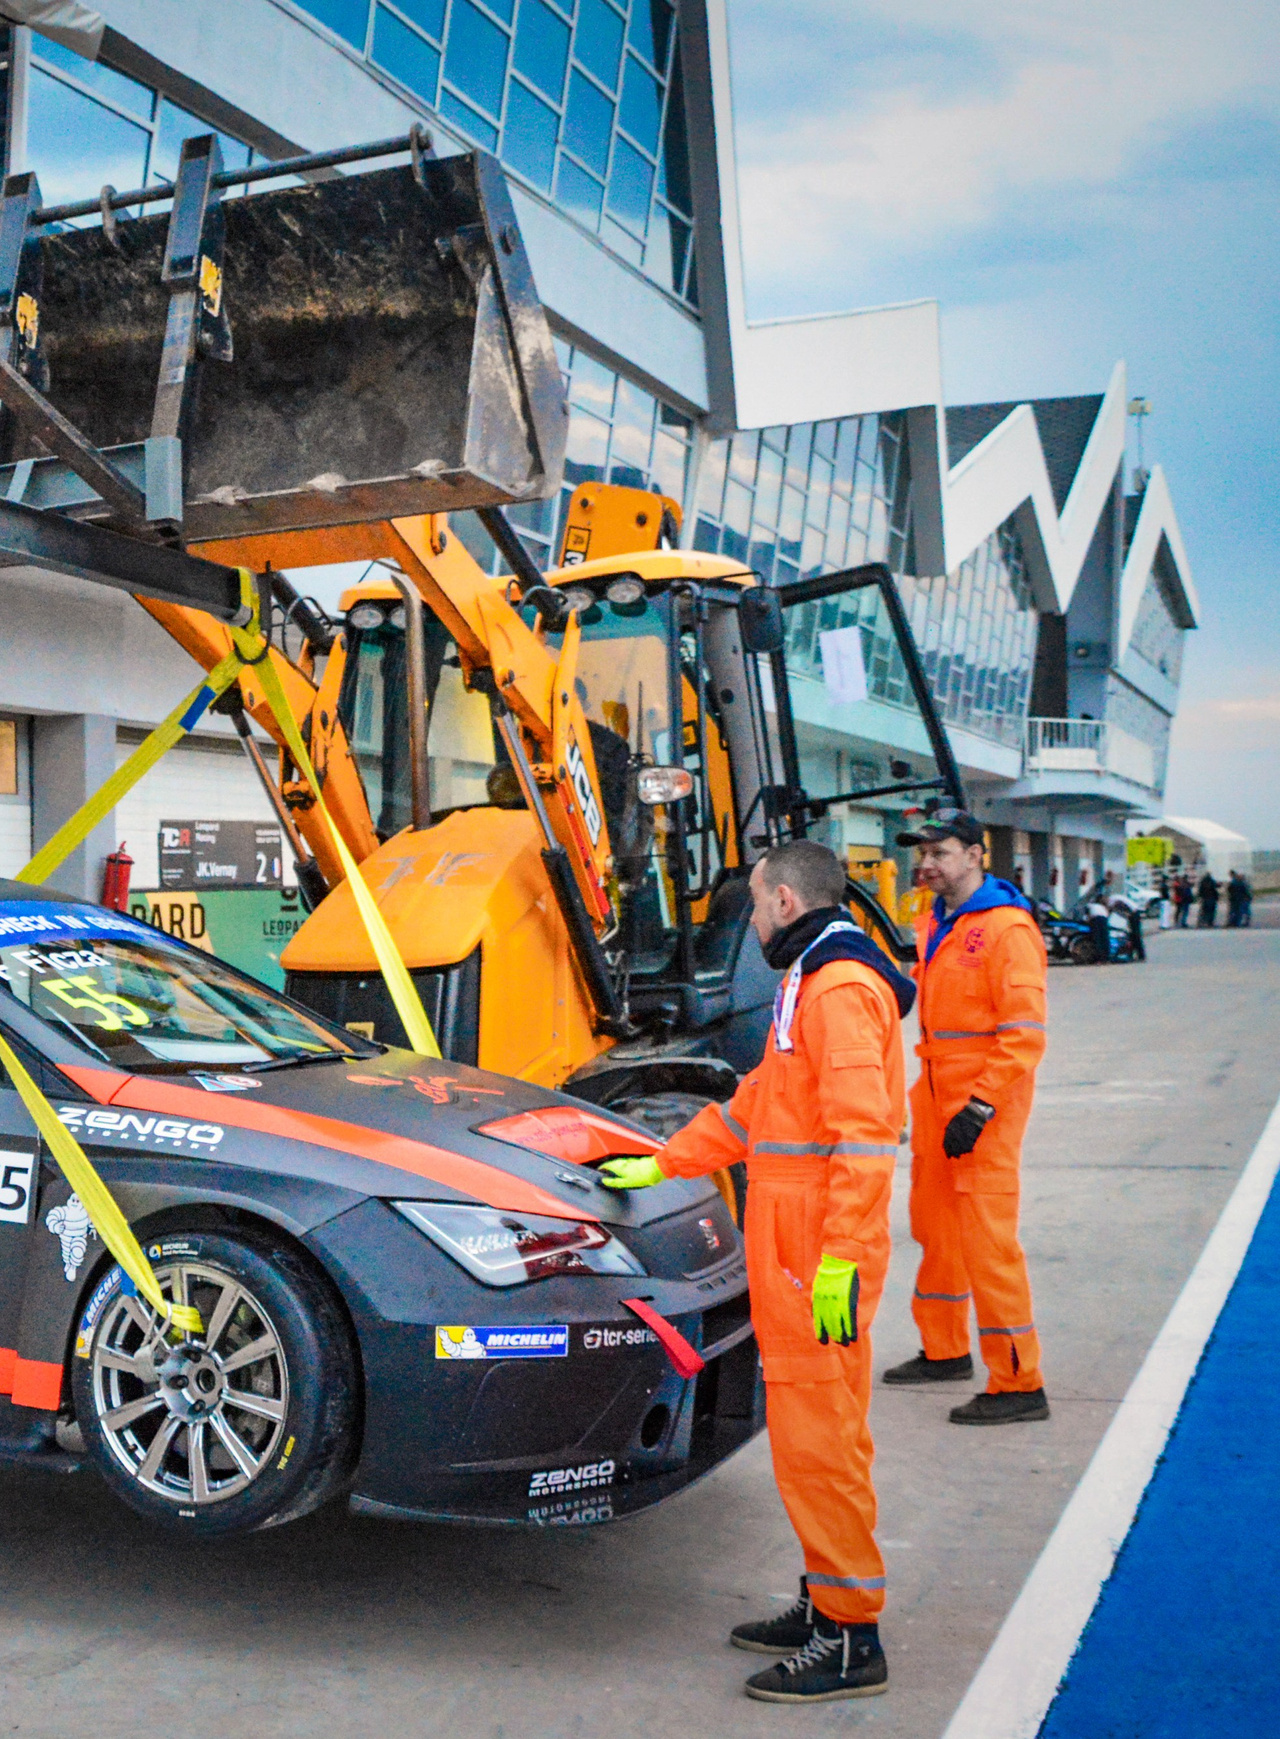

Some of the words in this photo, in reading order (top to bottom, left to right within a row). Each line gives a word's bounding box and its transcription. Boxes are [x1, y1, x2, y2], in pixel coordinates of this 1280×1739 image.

[565, 741, 602, 847] JCB
[161, 827, 191, 848] TCR
[255, 851, 267, 883] 2
[262, 919, 306, 937] LEOPA
[10, 949, 112, 974] Ficza
[39, 975, 151, 1031] 55
[69, 1126, 218, 1153] OTORSPORT
[85, 1268, 121, 1324] MICHE
[485, 1332, 567, 1347] MICHELIN
[603, 1328, 661, 1347] tcr-serie
[527, 1476, 614, 1498] MOTORSPORT
